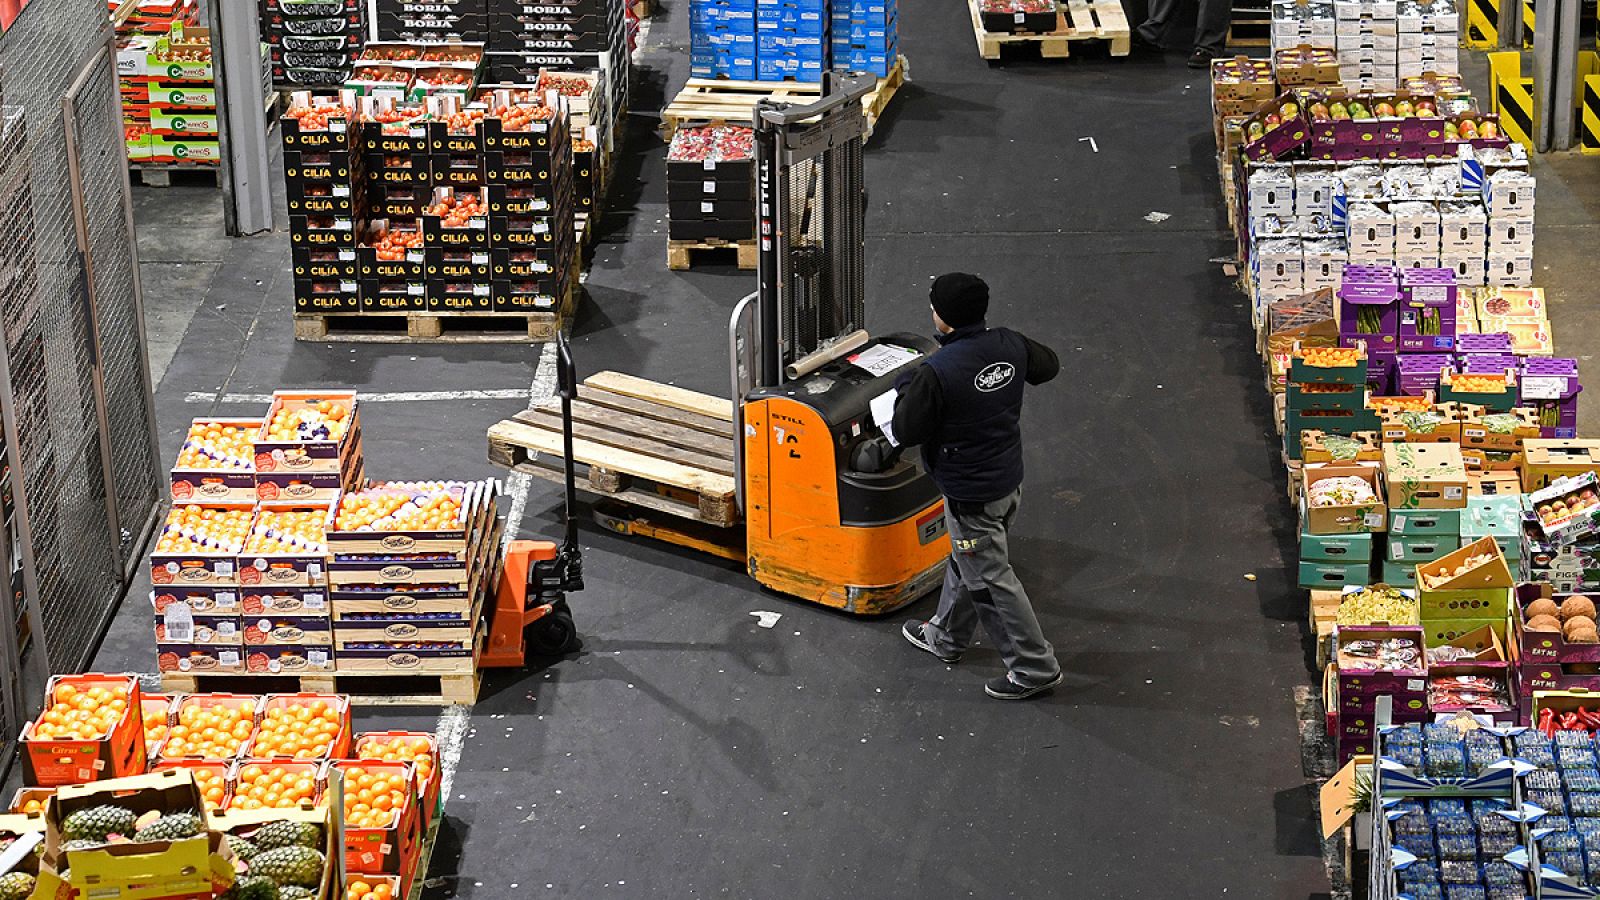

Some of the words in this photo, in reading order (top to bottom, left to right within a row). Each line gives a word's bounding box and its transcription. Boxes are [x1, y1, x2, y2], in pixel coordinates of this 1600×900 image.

[760, 160, 769, 216] STILL
[772, 413, 805, 426] STILL
[1566, 521, 1588, 533] FIGS
[1532, 648, 1546, 656] EAT
